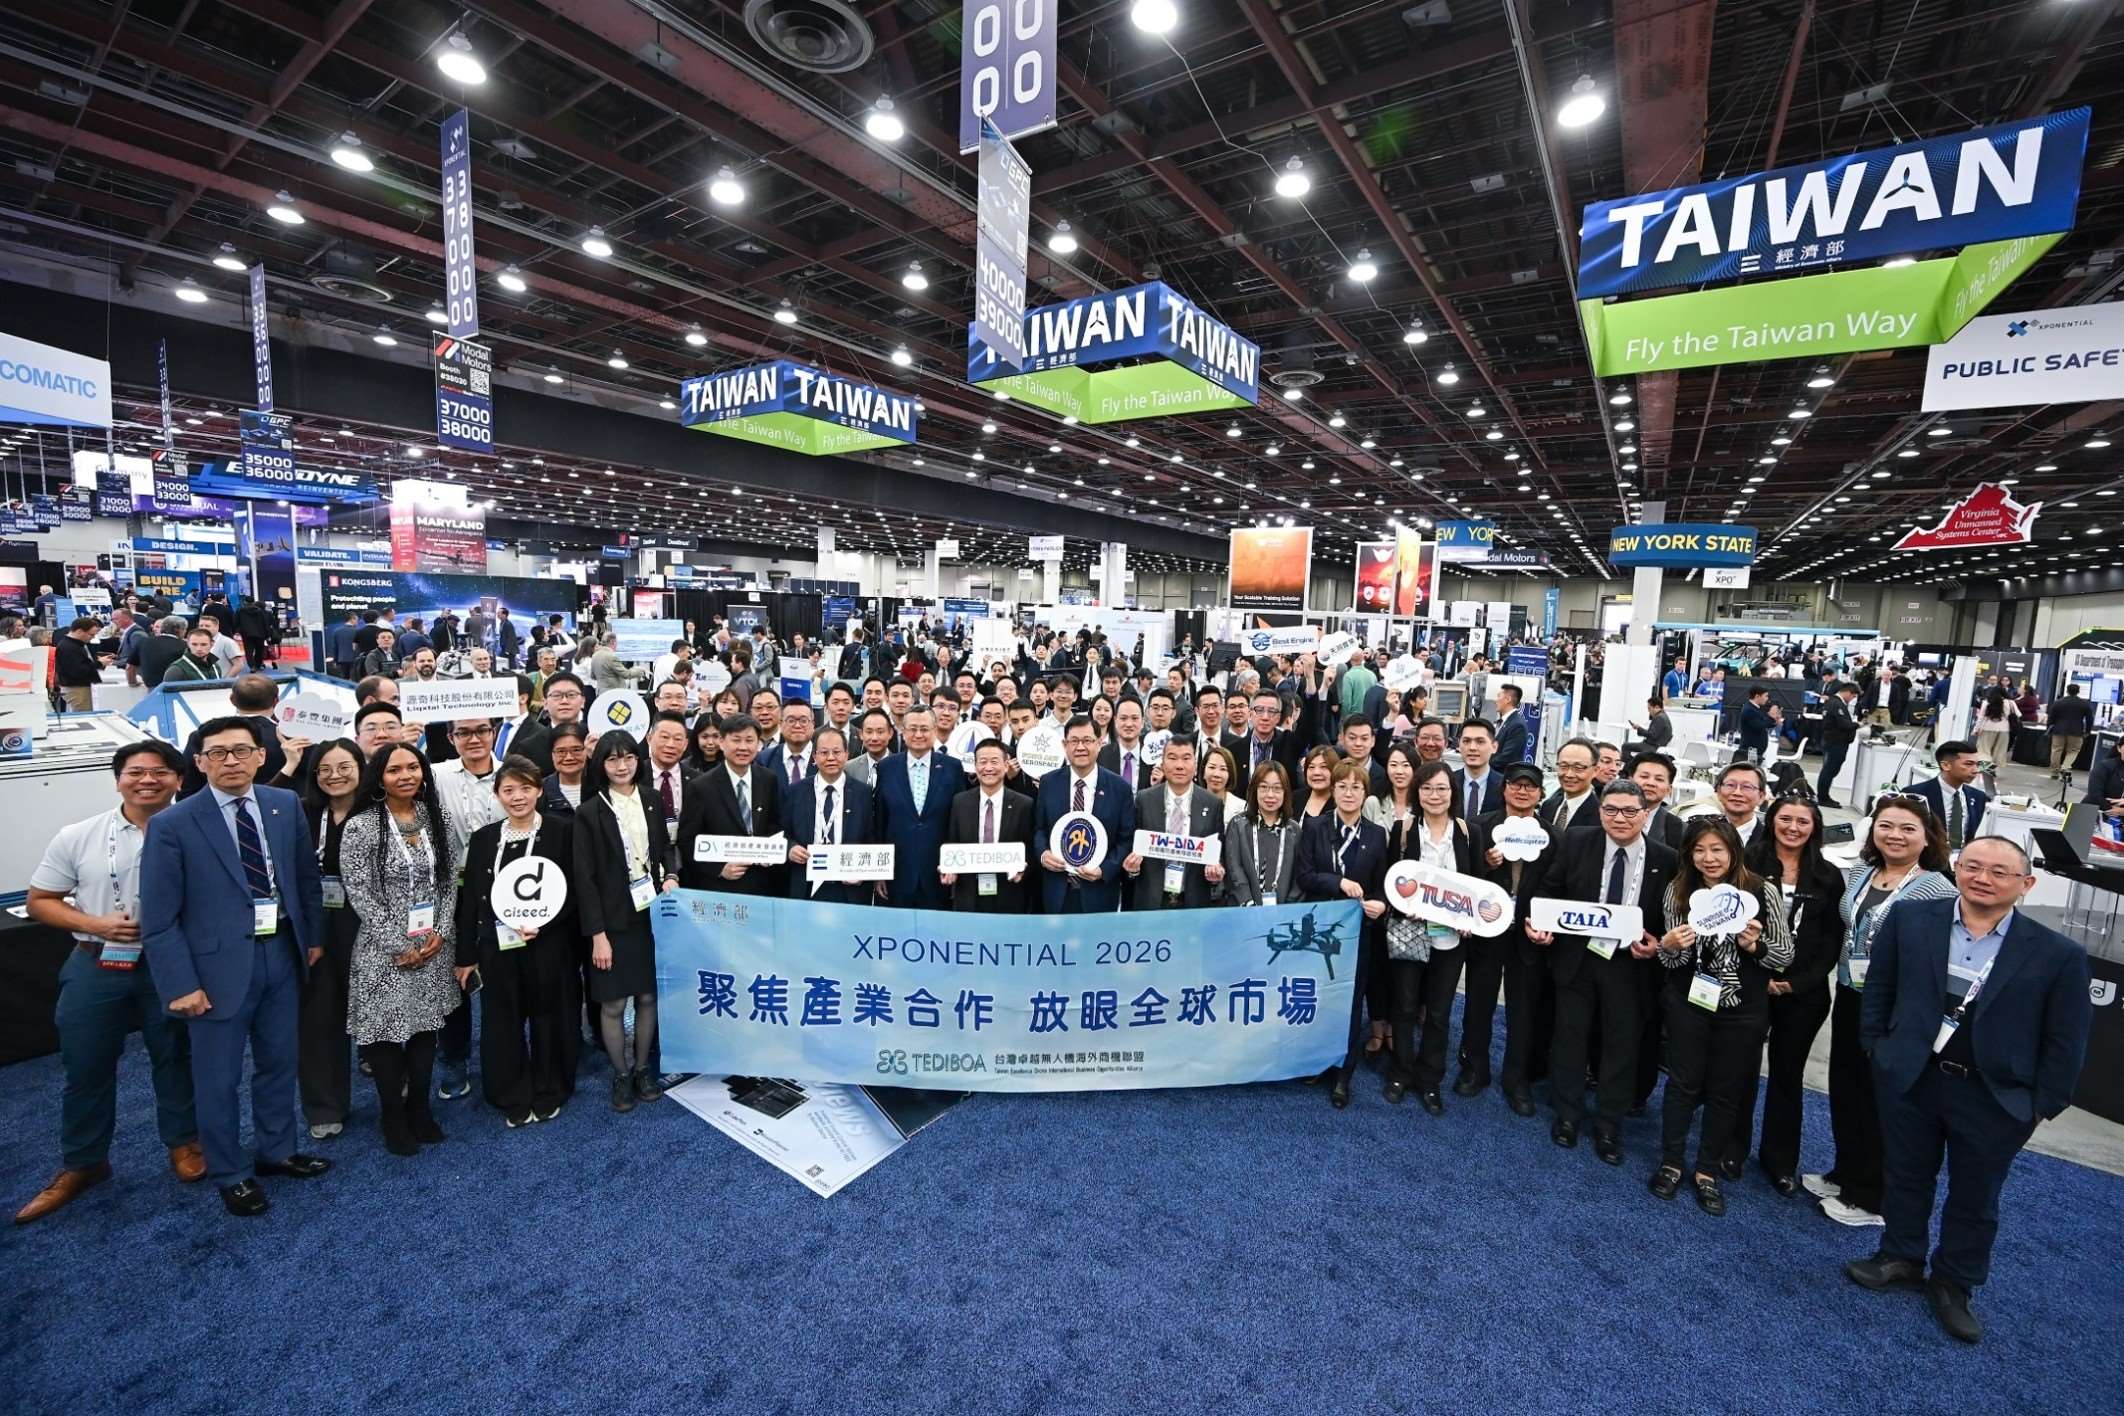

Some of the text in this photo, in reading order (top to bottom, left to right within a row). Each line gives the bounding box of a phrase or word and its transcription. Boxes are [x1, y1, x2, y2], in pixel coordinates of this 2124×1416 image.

[1608, 125, 2044, 269] TAIWAN
[1776, 240, 1845, 264] 經濟部
[980, 252, 1023, 316] 40000
[980, 292, 1022, 351] 39000
[986, 289, 1146, 366] IWAN
[2038, 319, 2093, 332] XPONENTIAL
[1166, 295, 1256, 388] TAIWAN
[1625, 309, 1918, 366] Fly the Taiwan Way
[462, 344, 489, 361] Modal
[462, 354, 492, 373] Motors
[1943, 349, 2124, 380] PUBLIC SAFE
[0, 360, 97, 399] COMATIC
[687, 367, 776, 414] TAIWAN
[1025, 376, 1061, 402] Taiwan
[1063, 390, 1083, 415] Way
[793, 368, 911, 432] TAIWAN
[1101, 397, 1120, 416] Fly
[1123, 393, 1148, 410] the
[1150, 387, 1202, 408] Taiwan
[440, 398, 490, 425] 37000
[441, 418, 491, 443] 38000
[742, 419, 782, 441] Taiwan
[784, 428, 808, 447] Way
[245, 452, 292, 469] 35000
[245, 466, 293, 482] 36000
[155, 480, 190, 493] 34000
[100, 495, 130, 506] 31000
[156, 490, 191, 502] 33000
[100, 504, 132, 514] 32000
[1959, 508, 2000, 521] Virginia
[416, 516, 485, 530] MARYLAND
[1954, 517, 2003, 530] Unmanned
[1436, 527, 1457, 541] EW
[1936, 530, 1971, 541] Systems
[1972, 528, 2001, 538] Center
[152, 541, 199, 551] DESIGN.
[1612, 534, 1753, 555] NEW YORK STATE
[304, 550, 352, 560] VALIDATE.
[1488, 553, 1537, 563] dal Motors
[140, 575, 187, 587] BUILD
[341, 578, 394, 588] KONGSBERG
[1271, 636, 1315, 646] Best Engine
[444, 702, 496, 712] Technology
[1150, 834, 1205, 852] TW-DIDA
[840, 852, 891, 868] 經濟部
[970, 851, 1023, 865] TEDIBOA
[1420, 883, 1474, 918] TUSA
[1562, 911, 1609, 928] TAIA
[1704, 916, 1731, 931] TAIWAN
[853, 934, 1172, 967] XPONENTIAL 2026
[697, 969, 1319, 1033] 聚焦產業合作 放眼全球市場
[912, 1053, 987, 1073] TEDIBOA
[995, 1051, 1145, 1065] 台灣卓越無人機海外商機聯盟
